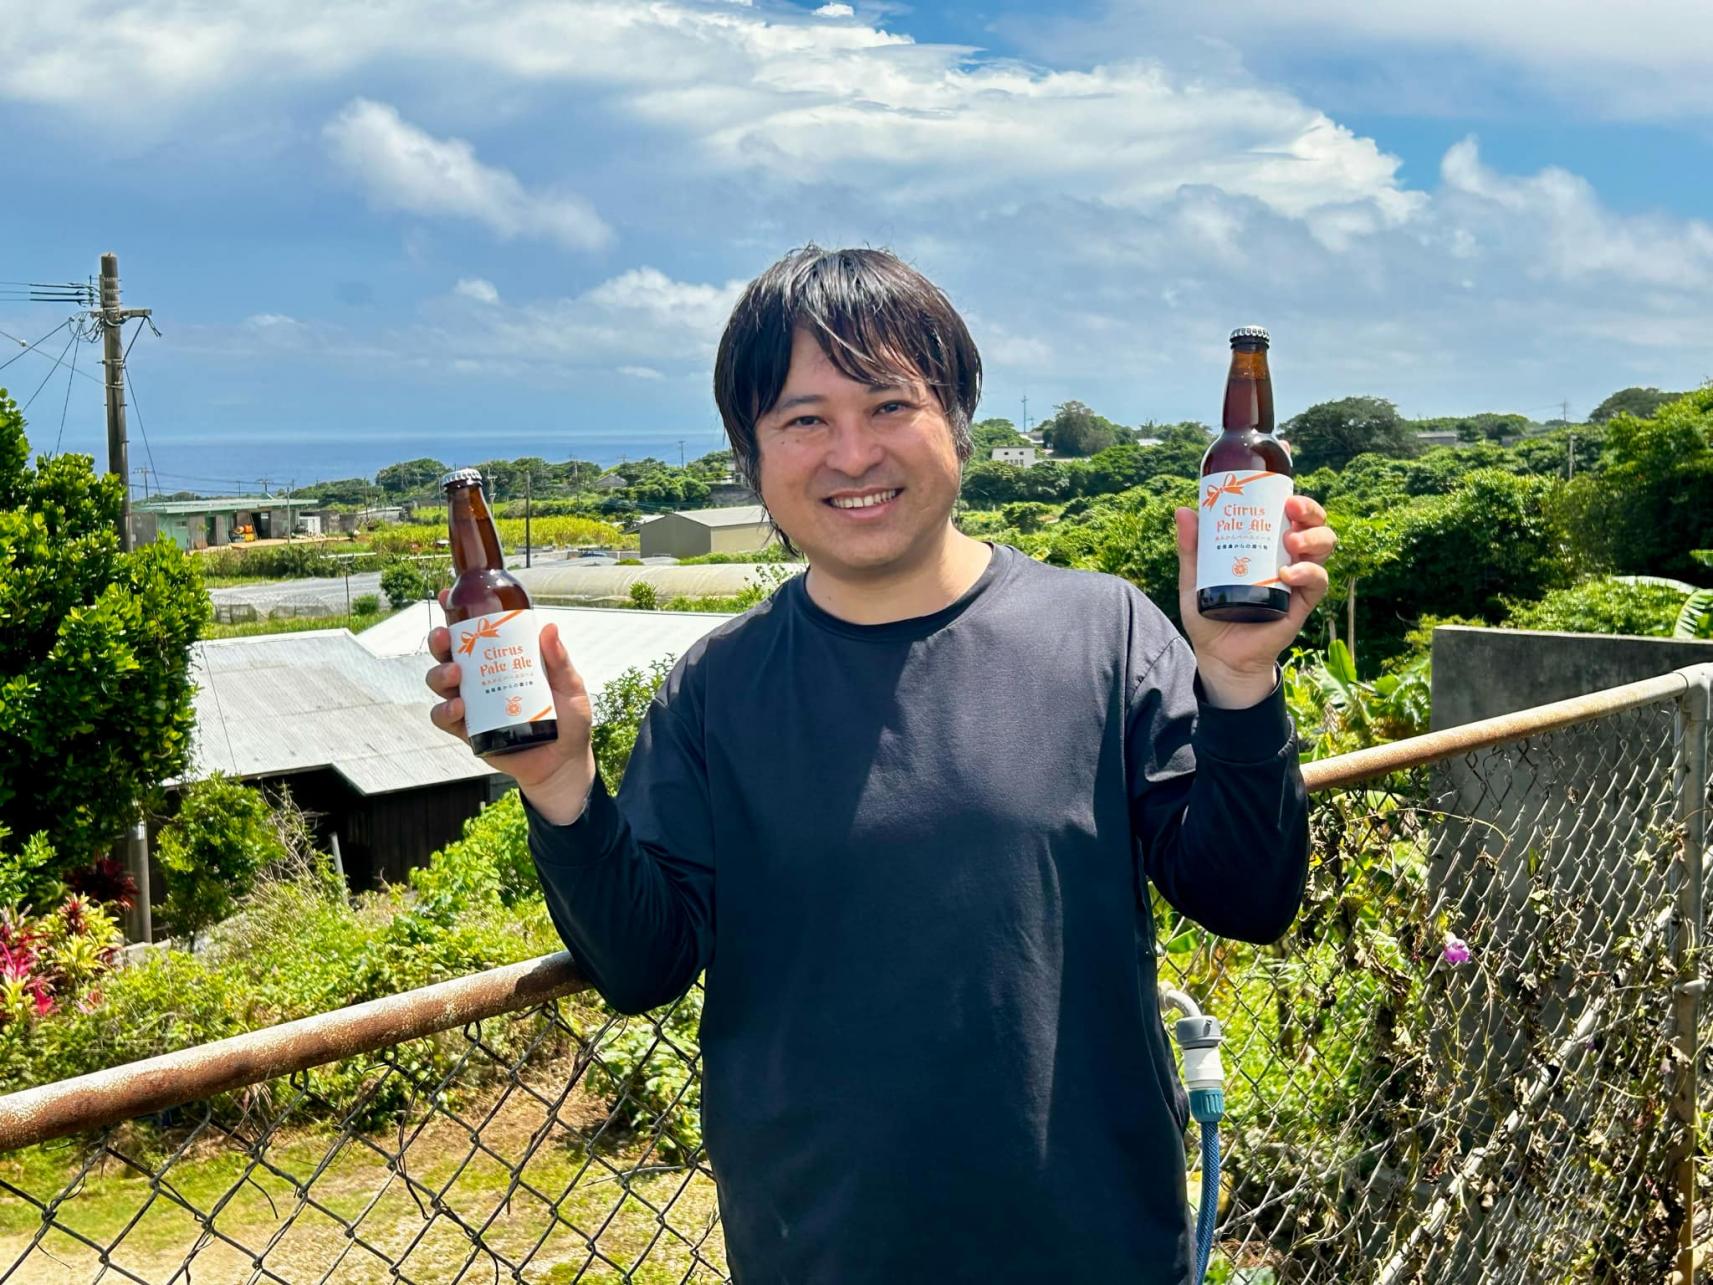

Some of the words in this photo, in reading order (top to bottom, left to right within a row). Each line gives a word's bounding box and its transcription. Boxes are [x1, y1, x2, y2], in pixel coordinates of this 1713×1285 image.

[1224, 504, 1265, 517] Citrus
[1216, 518, 1243, 533] Pale
[1248, 519, 1272, 532] Ale
[483, 645, 524, 660] Citrus
[480, 661, 506, 677] Pale
[512, 656, 533, 670] Ale
